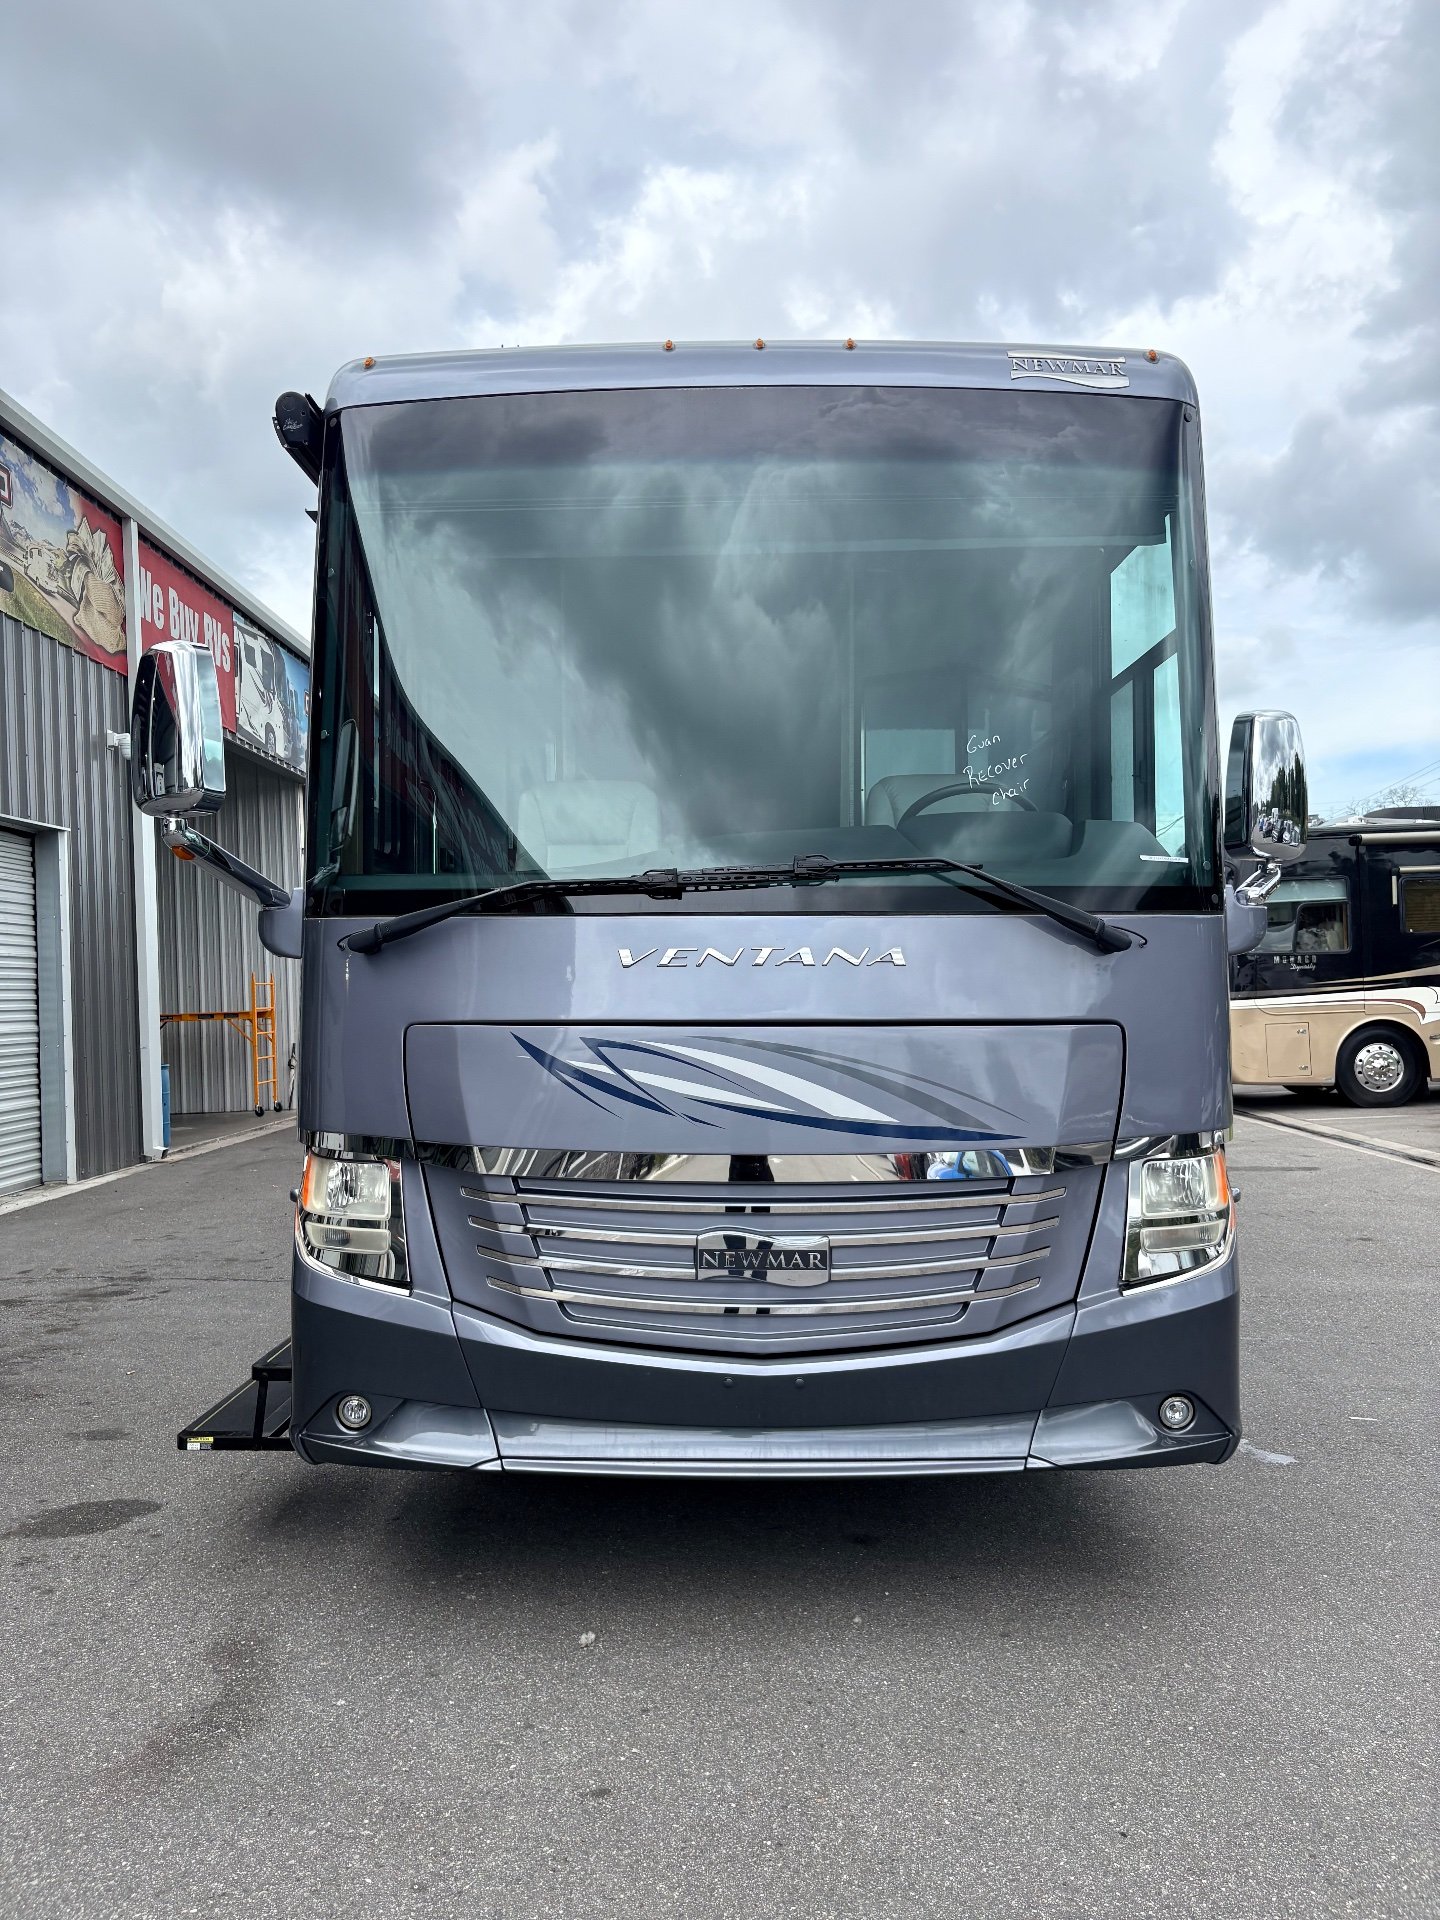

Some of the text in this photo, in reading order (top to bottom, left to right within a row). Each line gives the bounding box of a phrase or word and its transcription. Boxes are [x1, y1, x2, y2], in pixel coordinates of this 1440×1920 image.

[1011, 358, 1127, 375] NEWMAR
[139, 566, 165, 630] We
[203, 611, 231, 673] RVs
[617, 947, 907, 968] VENTANA
[700, 1251, 826, 1269] NEWMAR
